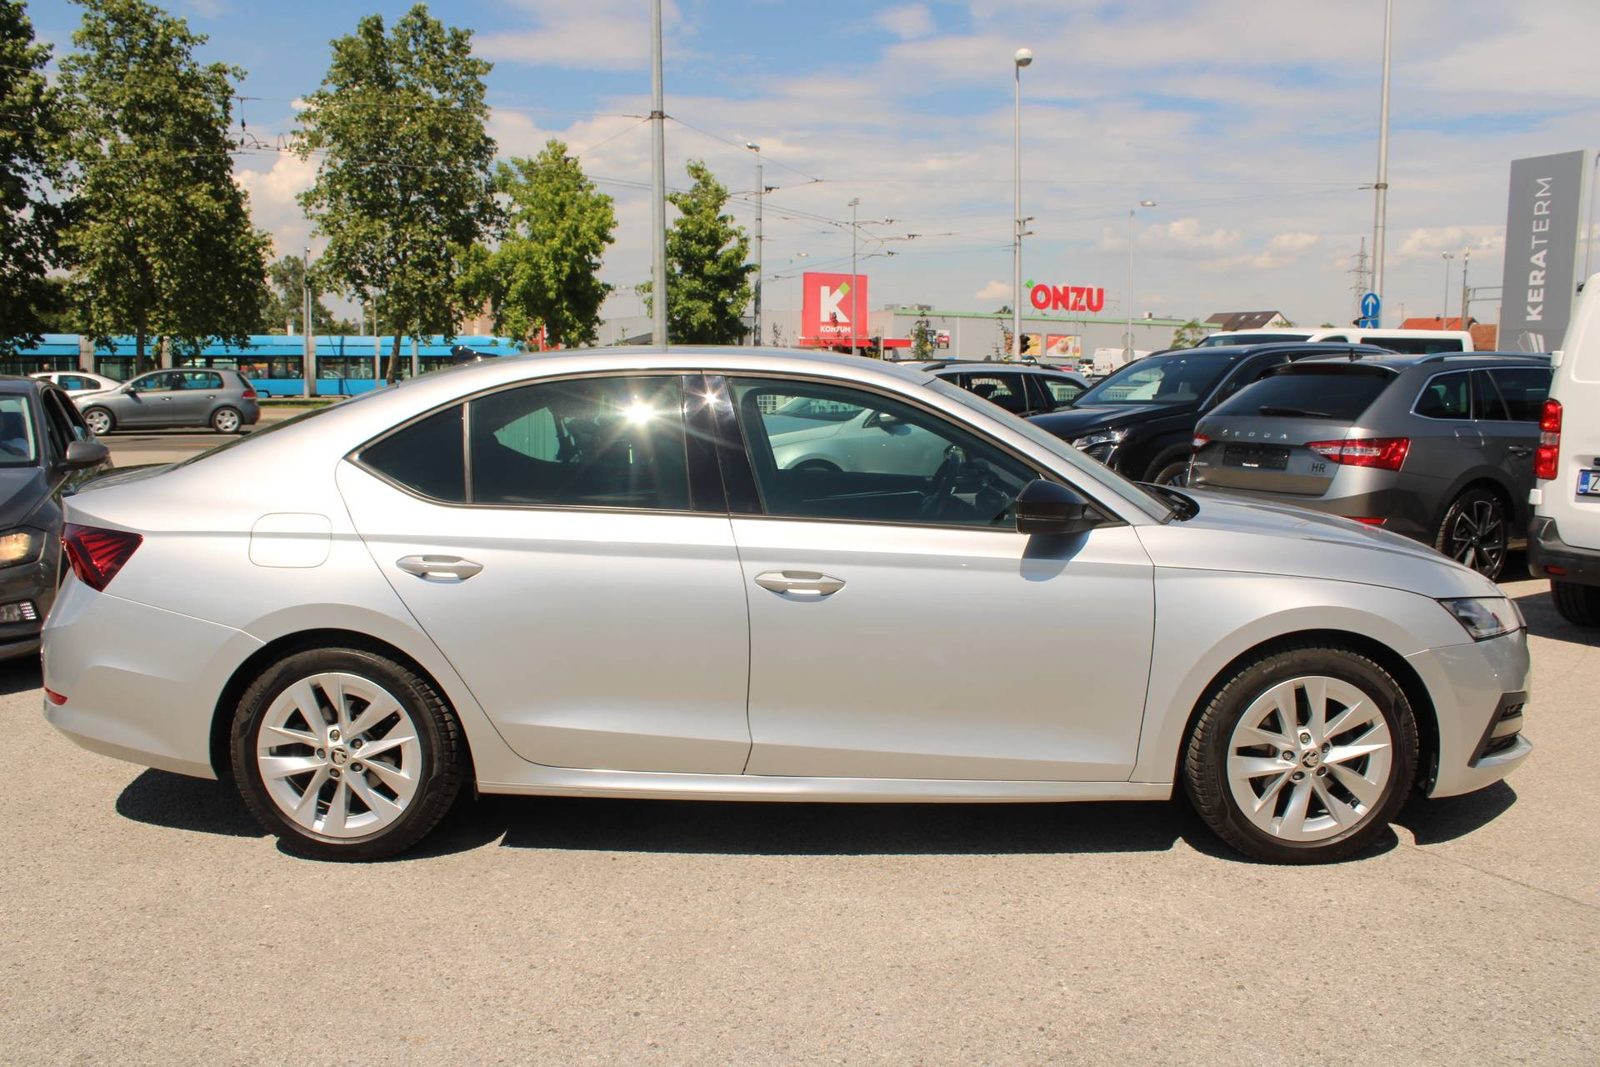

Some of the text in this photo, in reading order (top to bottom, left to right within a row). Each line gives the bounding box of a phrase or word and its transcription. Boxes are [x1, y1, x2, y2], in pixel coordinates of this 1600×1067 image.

[1526, 177, 1552, 321] KERATERM
[820, 282, 850, 323] K
[1030, 284, 1104, 312] ONZU
[1311, 463, 1326, 473] HR
